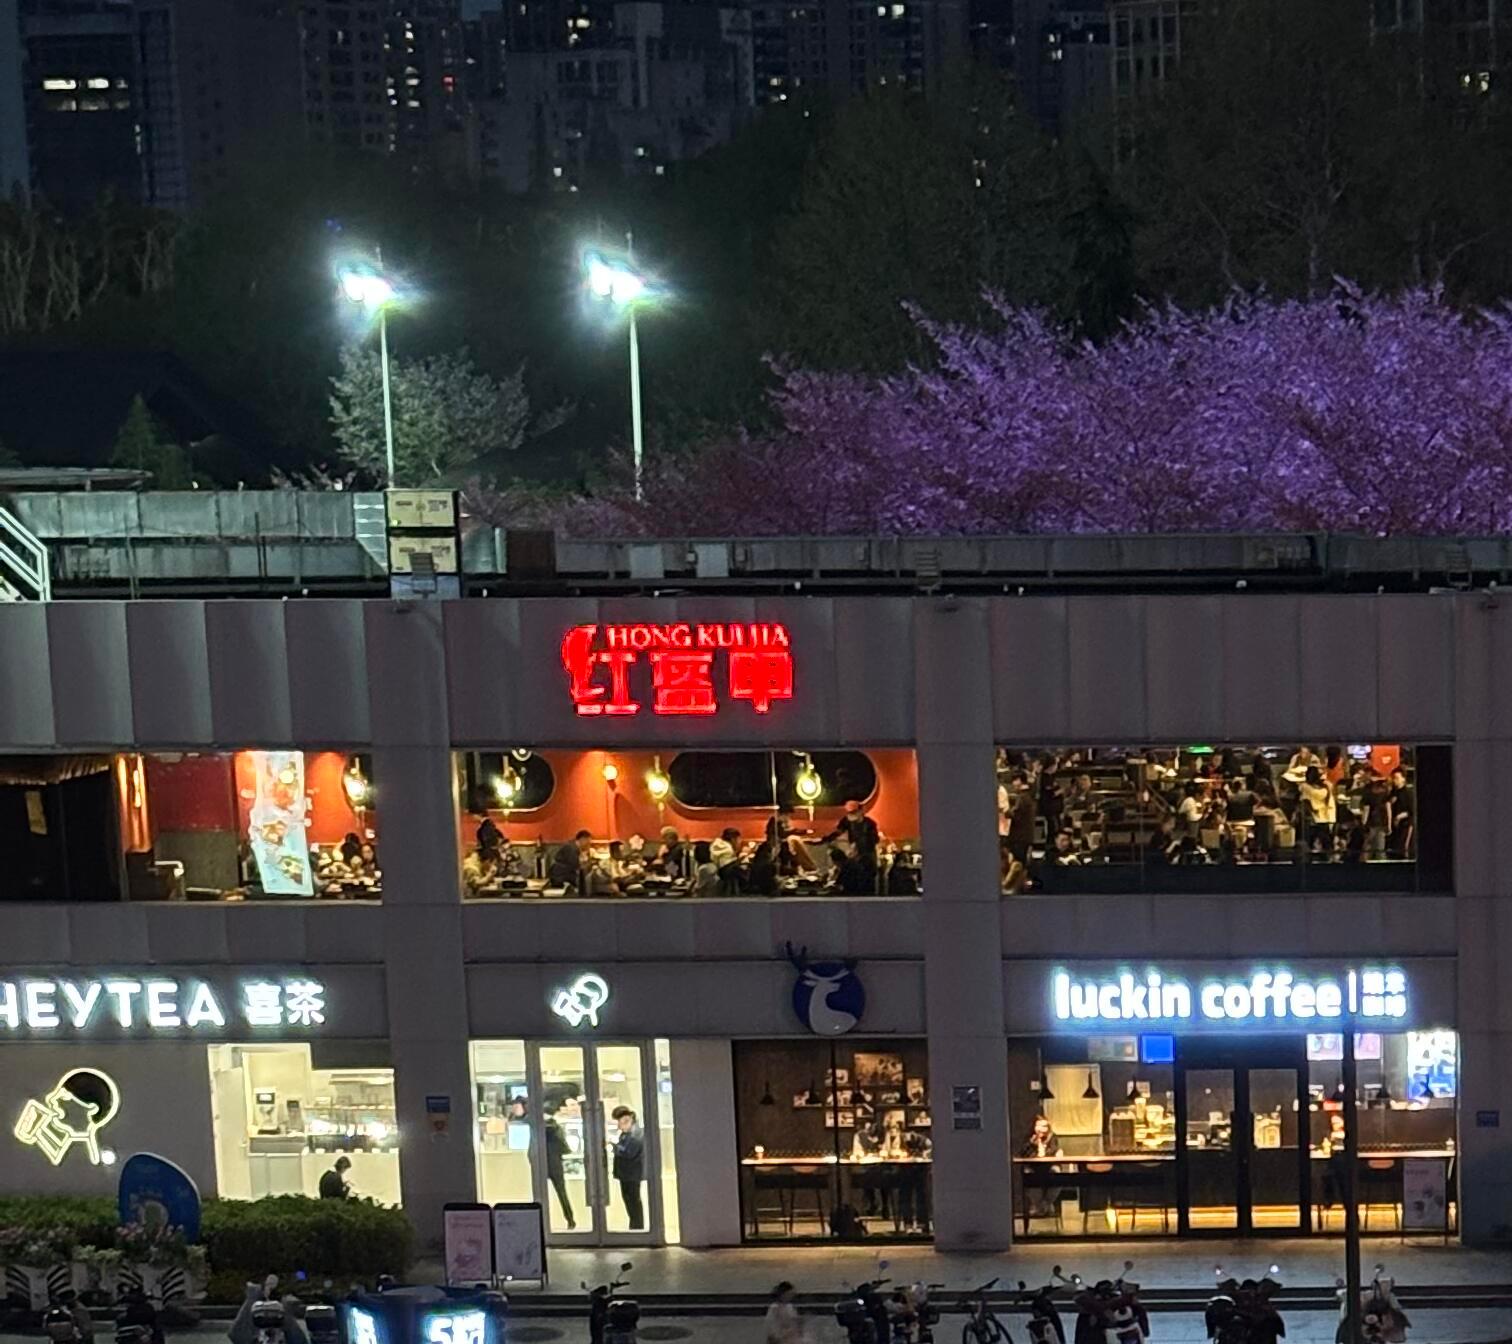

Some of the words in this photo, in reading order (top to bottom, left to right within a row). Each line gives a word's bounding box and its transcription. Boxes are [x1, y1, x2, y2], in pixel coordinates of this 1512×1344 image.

[606, 624, 692, 648] HONG
[697, 623, 745, 648] KUI
[750, 623, 790, 648] JIA
[562, 626, 793, 714] 红盔甲
[244, 982, 326, 1027] 喜茶
[1054, 973, 1191, 1019] luckin
[1201, 973, 1342, 1018] coffee
